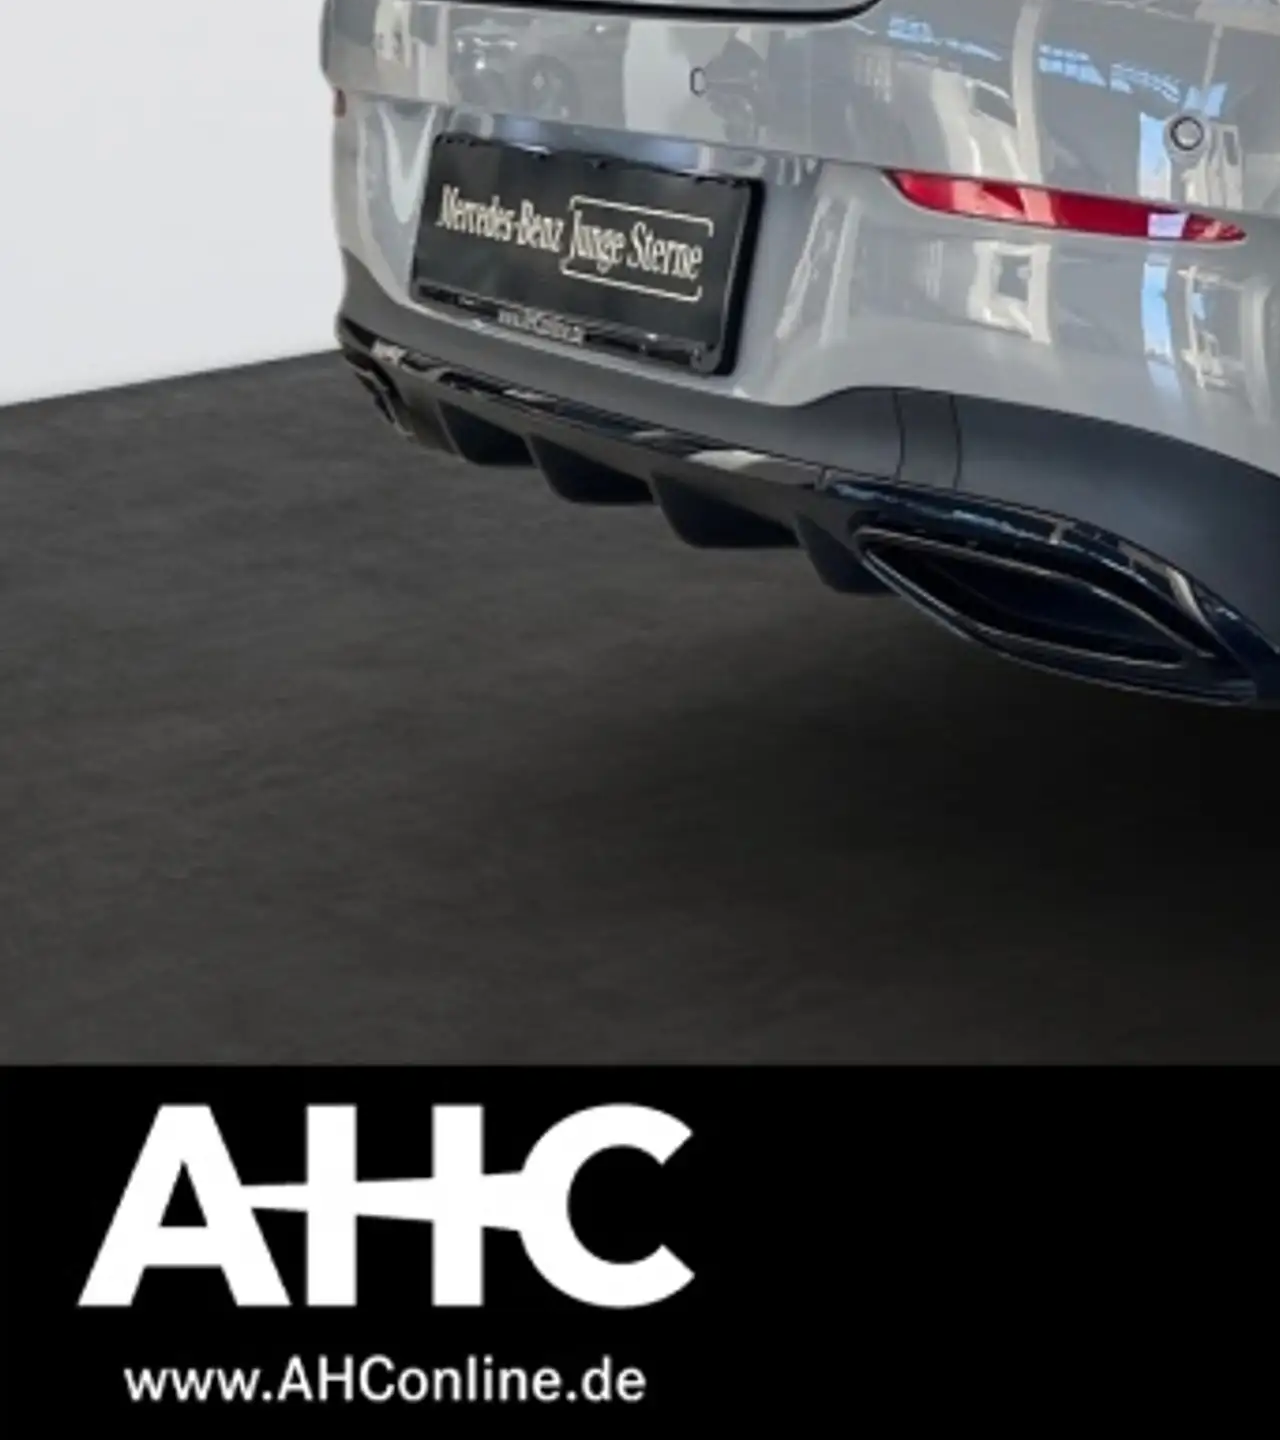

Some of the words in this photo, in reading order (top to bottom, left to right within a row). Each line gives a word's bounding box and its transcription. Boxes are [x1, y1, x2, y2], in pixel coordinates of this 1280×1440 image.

[436, 183, 566, 253] Mercedes-Benz
[570, 209, 628, 274] Junge
[626, 220, 703, 281] Sterne
